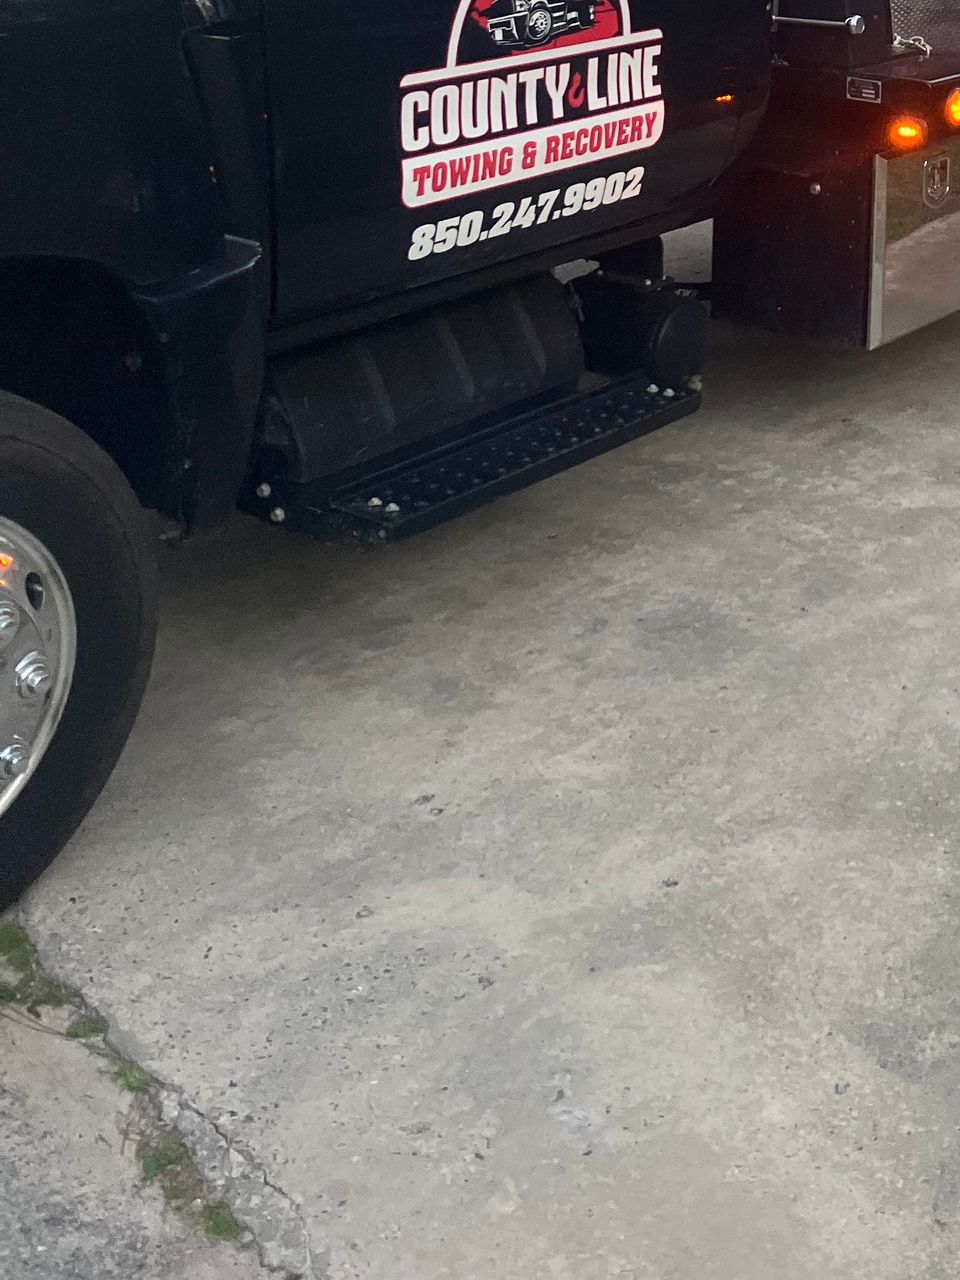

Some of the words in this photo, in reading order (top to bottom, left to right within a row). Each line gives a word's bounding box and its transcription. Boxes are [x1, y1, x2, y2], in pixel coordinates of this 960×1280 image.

[401, 62, 571, 151] COUNTY
[587, 45, 661, 111] LINE
[412, 146, 513, 197] TOWING
[521, 140, 537, 170] &
[544, 111, 657, 164] RECOVERY
[408, 166, 645, 261] 850.247.9902
